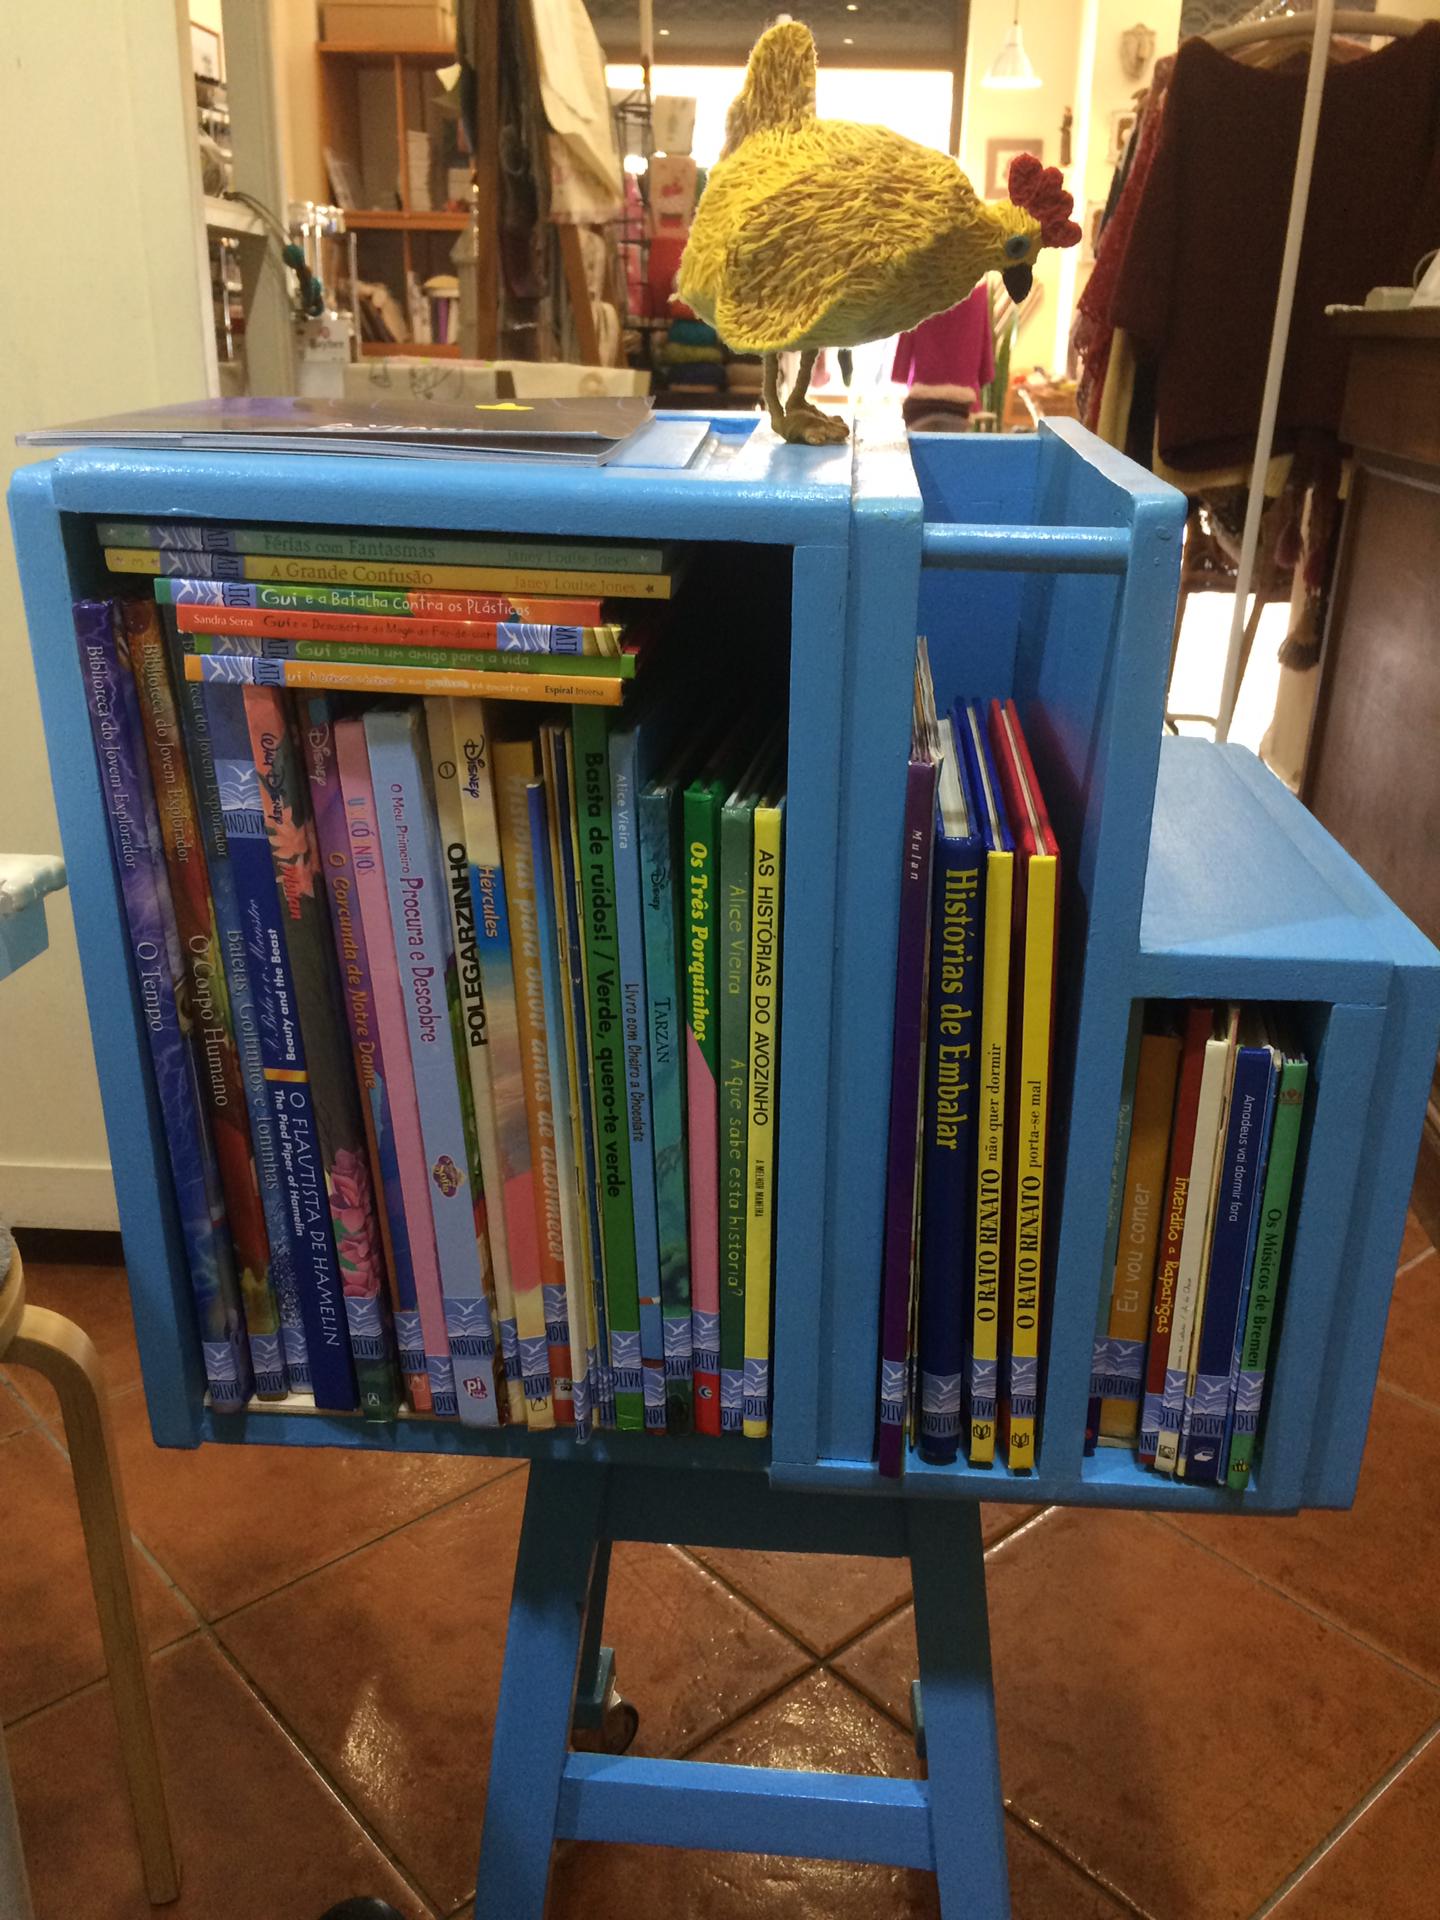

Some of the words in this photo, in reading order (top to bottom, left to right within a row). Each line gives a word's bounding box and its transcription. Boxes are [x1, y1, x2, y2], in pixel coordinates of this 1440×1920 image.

[264, 535, 310, 554] Férias
[321, 543, 345, 555] com
[349, 538, 436, 559] Fantasmas
[507, 551, 543, 566] Janey
[548, 551, 586, 563] Louise
[593, 552, 629, 567] Jones
[272, 566, 281, 577] A
[286, 565, 346, 580] Grande
[352, 567, 434, 585] Confusão
[513, 576, 550, 592] Janey
[555, 578, 590, 591] Louise
[596, 579, 637, 595] Jones
[193, 614, 227, 626] Sandra
[229, 616, 254, 628] Serra
[261, 588, 298, 606] Gui
[305, 597, 313, 605] e
[318, 596, 326, 605] a
[448, 603, 463, 613] os
[295, 641, 331, 657] Gui
[338, 646, 380, 662] ganha
[384, 649, 401, 660] um
[409, 650, 447, 664] amigo
[451, 654, 485, 667] para
[488, 655, 496, 663] a
[502, 654, 530, 667] vida
[87, 645, 111, 717] Biblioteca
[142, 642, 167, 714] Biblioteca
[288, 670, 302, 683] ui
[544, 684, 574, 698] Espiral
[100, 721, 116, 740] do
[156, 719, 171, 737] do
[192, 712, 207, 733] do
[99, 745, 123, 788] Jovem
[154, 740, 177, 784] Jovem
[194, 736, 215, 779] Jovem
[390, 783, 403, 793] O
[584, 751, 605, 818] Basta
[615, 773, 628, 807] Alice
[166, 789, 192, 864] Explorador
[206, 783, 229, 857] Explorador
[391, 797, 405, 821] Meu
[617, 810, 629, 849] Vieira
[111, 793, 137, 869] Explorador
[395, 824, 411, 873] Primeiro
[589, 826, 610, 855] de
[328, 851, 347, 867] O
[689, 841, 709, 868] Os
[758, 849, 775, 877] AS
[909, 829, 923, 881] Mulan
[400, 877, 424, 946] Procura
[478, 864, 501, 937] Hércules
[590, 863, 614, 941] ruídos!
[690, 873, 710, 919] Três
[728, 884, 748, 933] Alice
[333, 876, 359, 961] Corcunda
[513, 898, 538, 957] para
[755, 886, 777, 986] HISTÓRIAS
[940, 867, 980, 994] Histórias
[136, 941, 159, 961] O
[188, 934, 209, 954] O
[267, 928, 282, 963] Beast
[410, 951, 424, 960] e
[446, 843, 489, 1048] POLEGARZINHO
[272, 967, 285, 987] the
[347, 964, 362, 985] de
[687, 925, 711, 1041] Porquinhos
[728, 939, 746, 995] Vieira
[140, 966, 165, 1032] Tempo
[190, 959, 216, 1021] Corpo
[276, 990, 289, 1015] and
[410, 966, 442, 1043] Descobre
[595, 969, 617, 1039] Verde,
[624, 983, 640, 1015] Livro
[754, 995, 771, 1025] DO
[347, 989, 371, 1036] Notre
[625, 1016, 639, 1041] com
[653, 997, 672, 1064] TARZAN
[939, 1004, 973, 1035] de
[240, 1002, 268, 1093] Golfinhos
[282, 1018, 297, 1061] Beauty
[203, 1026, 230, 1107] Humano
[358, 1040, 379, 1088] Dame
[531, 1038, 553, 1102] antes
[628, 1045, 643, 1077] Cheiro
[730, 1058, 747, 1070] A
[753, 1031, 771, 1126] AVOZINHO
[985, 1043, 1001, 1094] dormir
[254, 1096, 266, 1107] e
[272, 1090, 286, 1110] The
[289, 1092, 306, 1108] O
[595, 1047, 620, 1134] quero-te
[724, 1077, 744, 1109] que
[936, 1043, 972, 1152] Embalar
[1027, 1080, 1042, 1106] mal
[277, 1113, 291, 1140] Pied
[537, 1110, 555, 1137] de
[630, 1091, 646, 1142] Chocolate
[988, 1098, 1003, 1132] quer
[1238, 1095, 1256, 1145] Amadeus
[281, 1142, 295, 1173] Piper
[728, 1117, 746, 1160] sabe
[985, 1136, 1000, 1161] não
[1028, 1110, 1042, 1167] porta-se
[1235, 1148, 1248, 1163] vai
[287, 1175, 298, 1189] of
[292, 1117, 322, 1223] FLAUTISTA
[605, 1140, 626, 1198] verde
[728, 1167, 745, 1208] esta
[755, 1165, 765, 1190] MELHOR
[1231, 1165, 1248, 1198] dormir
[289, 1191, 306, 1236] Hamelin
[541, 1145, 564, 1263] adormecer
[754, 1191, 765, 1217] MANEIRA
[979, 1168, 1001, 1247] RENATO
[1019, 1175, 1041, 1252] RENATO
[1129, 1183, 1150, 1244] comer
[1167, 1176, 1189, 1241] Interdito
[1228, 1201, 1243, 1222] fora
[1266, 1208, 1283, 1228] Os
[309, 1231, 328, 1251] DE
[1256, 1232, 1279, 1290] Músicos
[977, 1250, 998, 1304] RATO
[1017, 1257, 1038, 1308] RATO
[1124, 1251, 1143, 1283] vou
[313, 1257, 340, 1347] HAMELIN
[976, 1307, 995, 1322] O
[1115, 1289, 1138, 1312] Eu
[1155, 1260, 1180, 1334] Raparigas
[1254, 1294, 1271, 1311] de
[1016, 1314, 1035, 1329] O
[1247, 1315, 1267, 1368] Bremen
